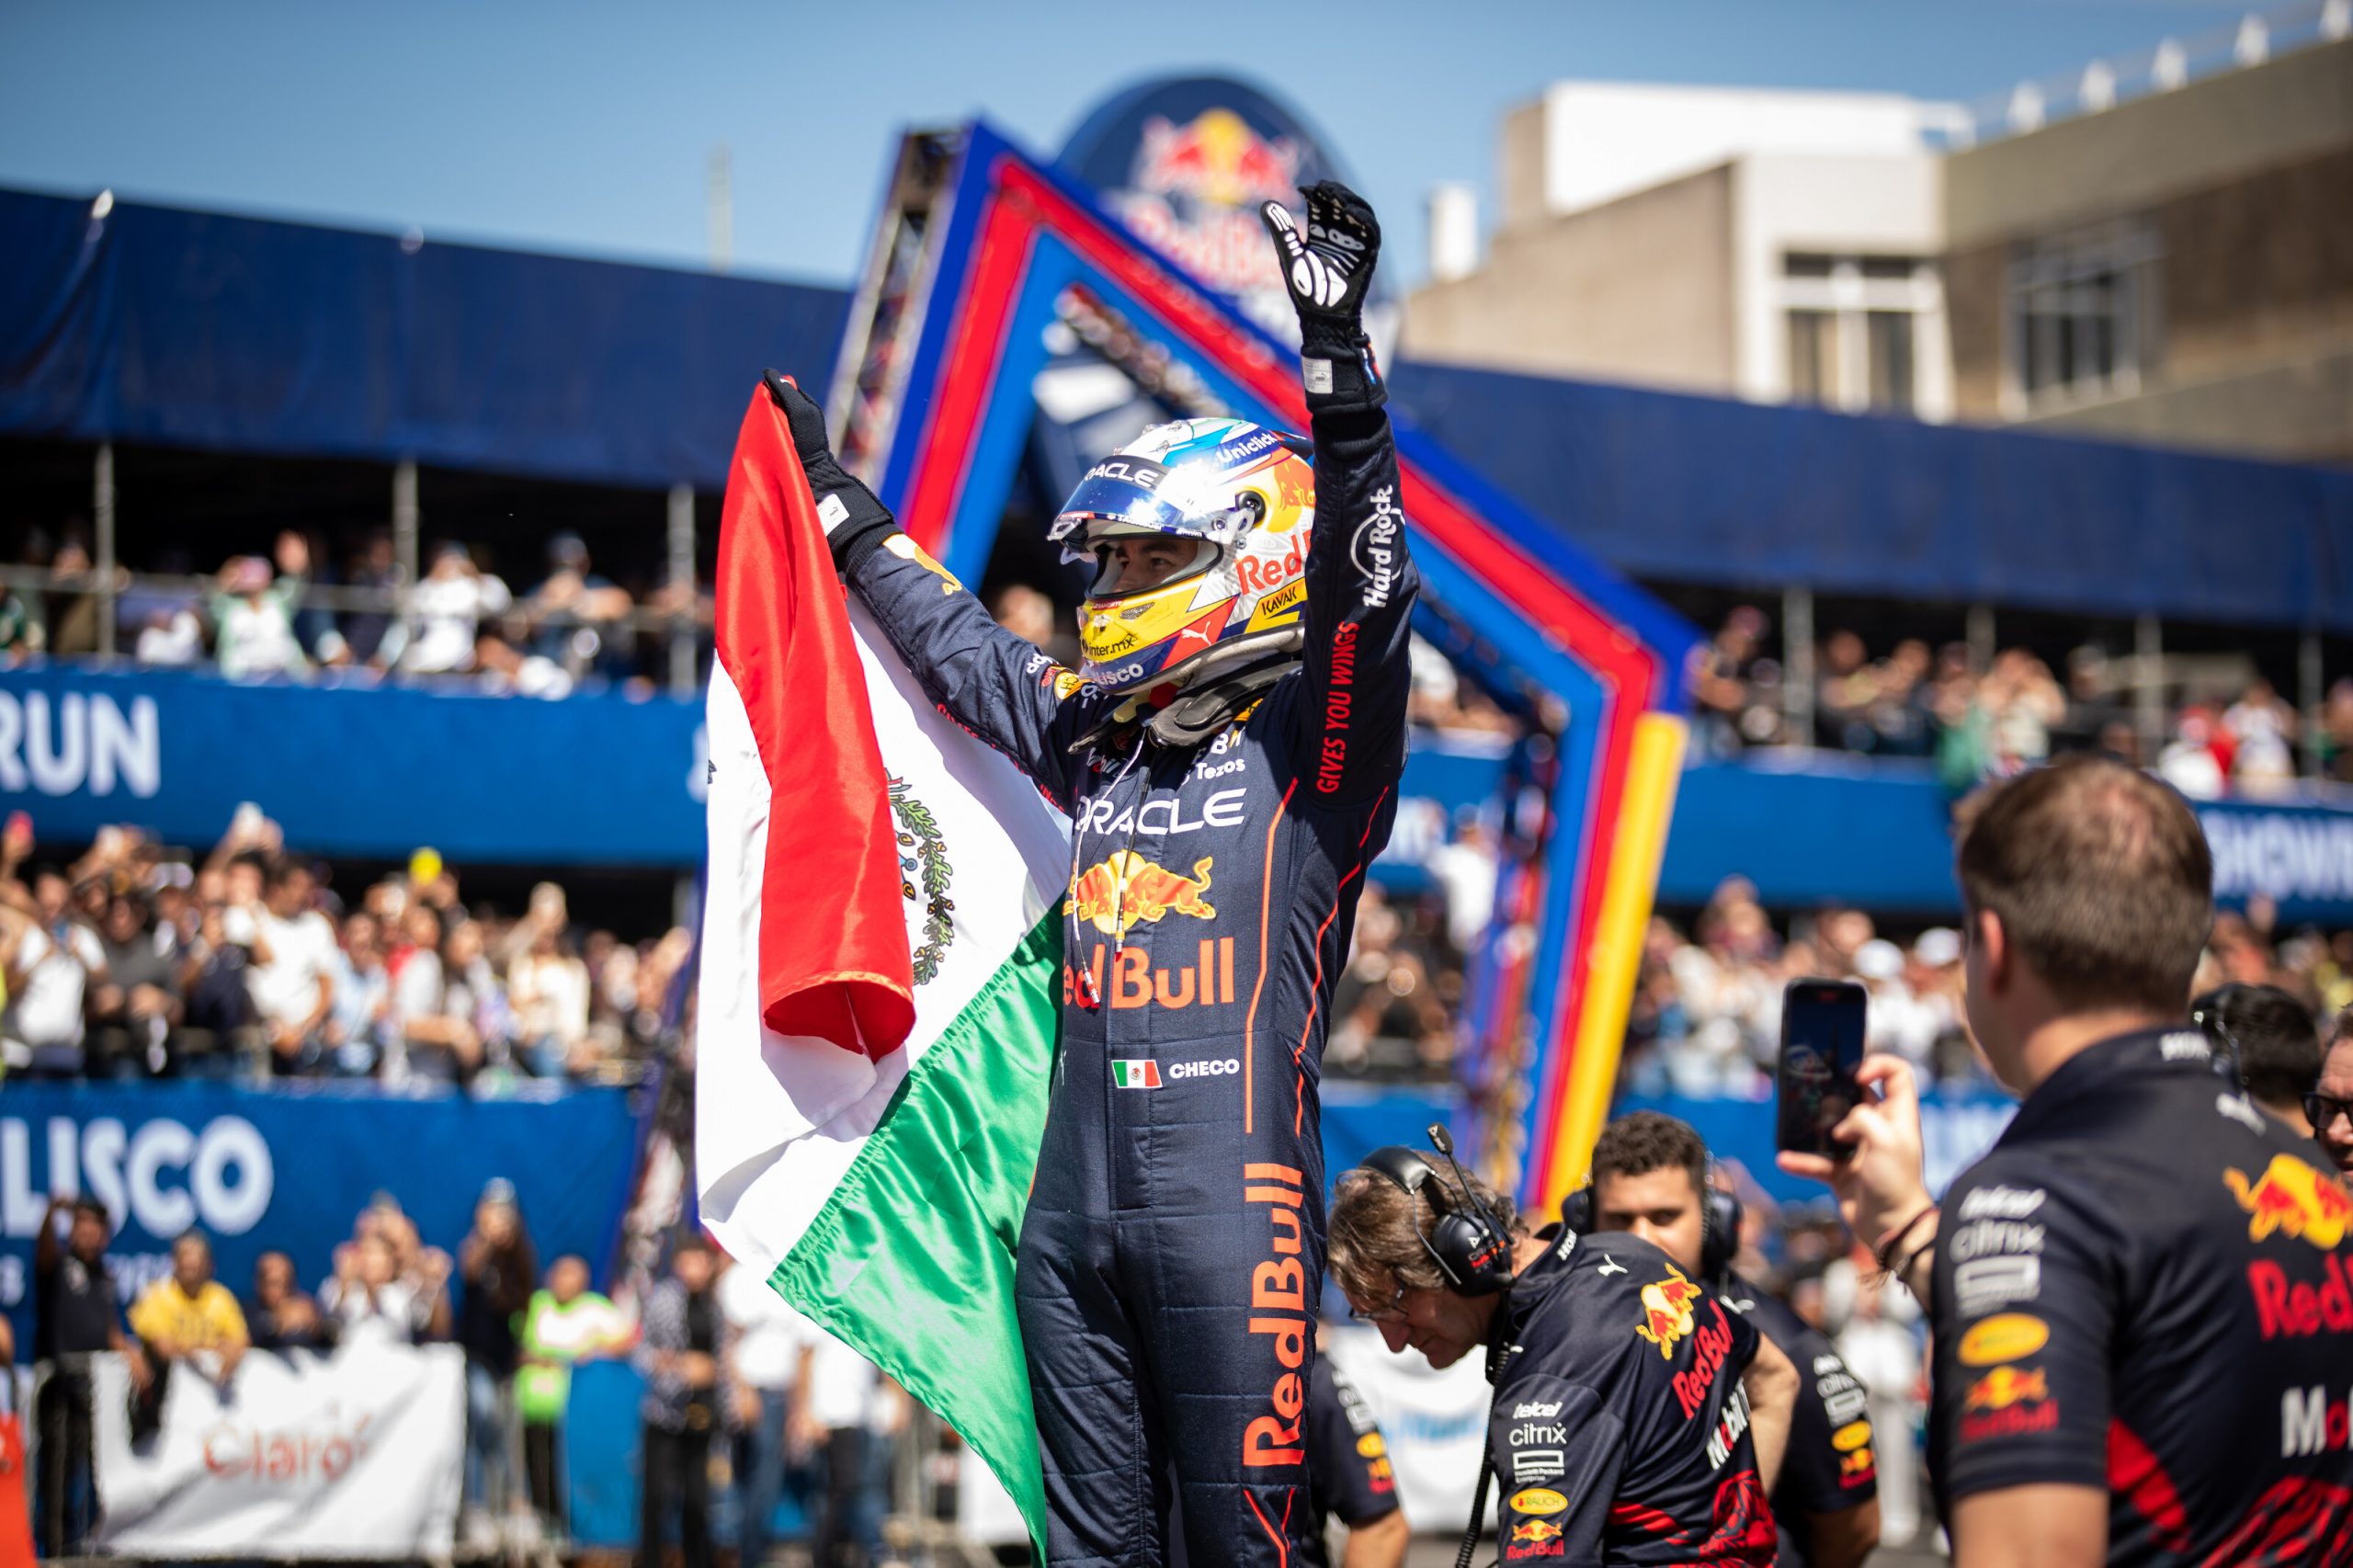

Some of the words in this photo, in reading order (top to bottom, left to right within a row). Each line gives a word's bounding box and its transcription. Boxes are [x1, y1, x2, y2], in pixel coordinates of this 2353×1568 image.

[1215, 432, 1279, 463] Uniclick
[1370, 484, 1398, 546] Rock
[1364, 547, 1392, 608] Hard
[1331, 619, 1362, 686] WINGS
[1325, 690, 1352, 731] YOU
[1196, 758, 1246, 780] Tezos
[1316, 736, 1347, 793] GIVES
[1168, 1058, 1240, 1079] CHECO
[1508, 1422, 1567, 1447] citrix
[1525, 1497, 1561, 1507] RAUCH
